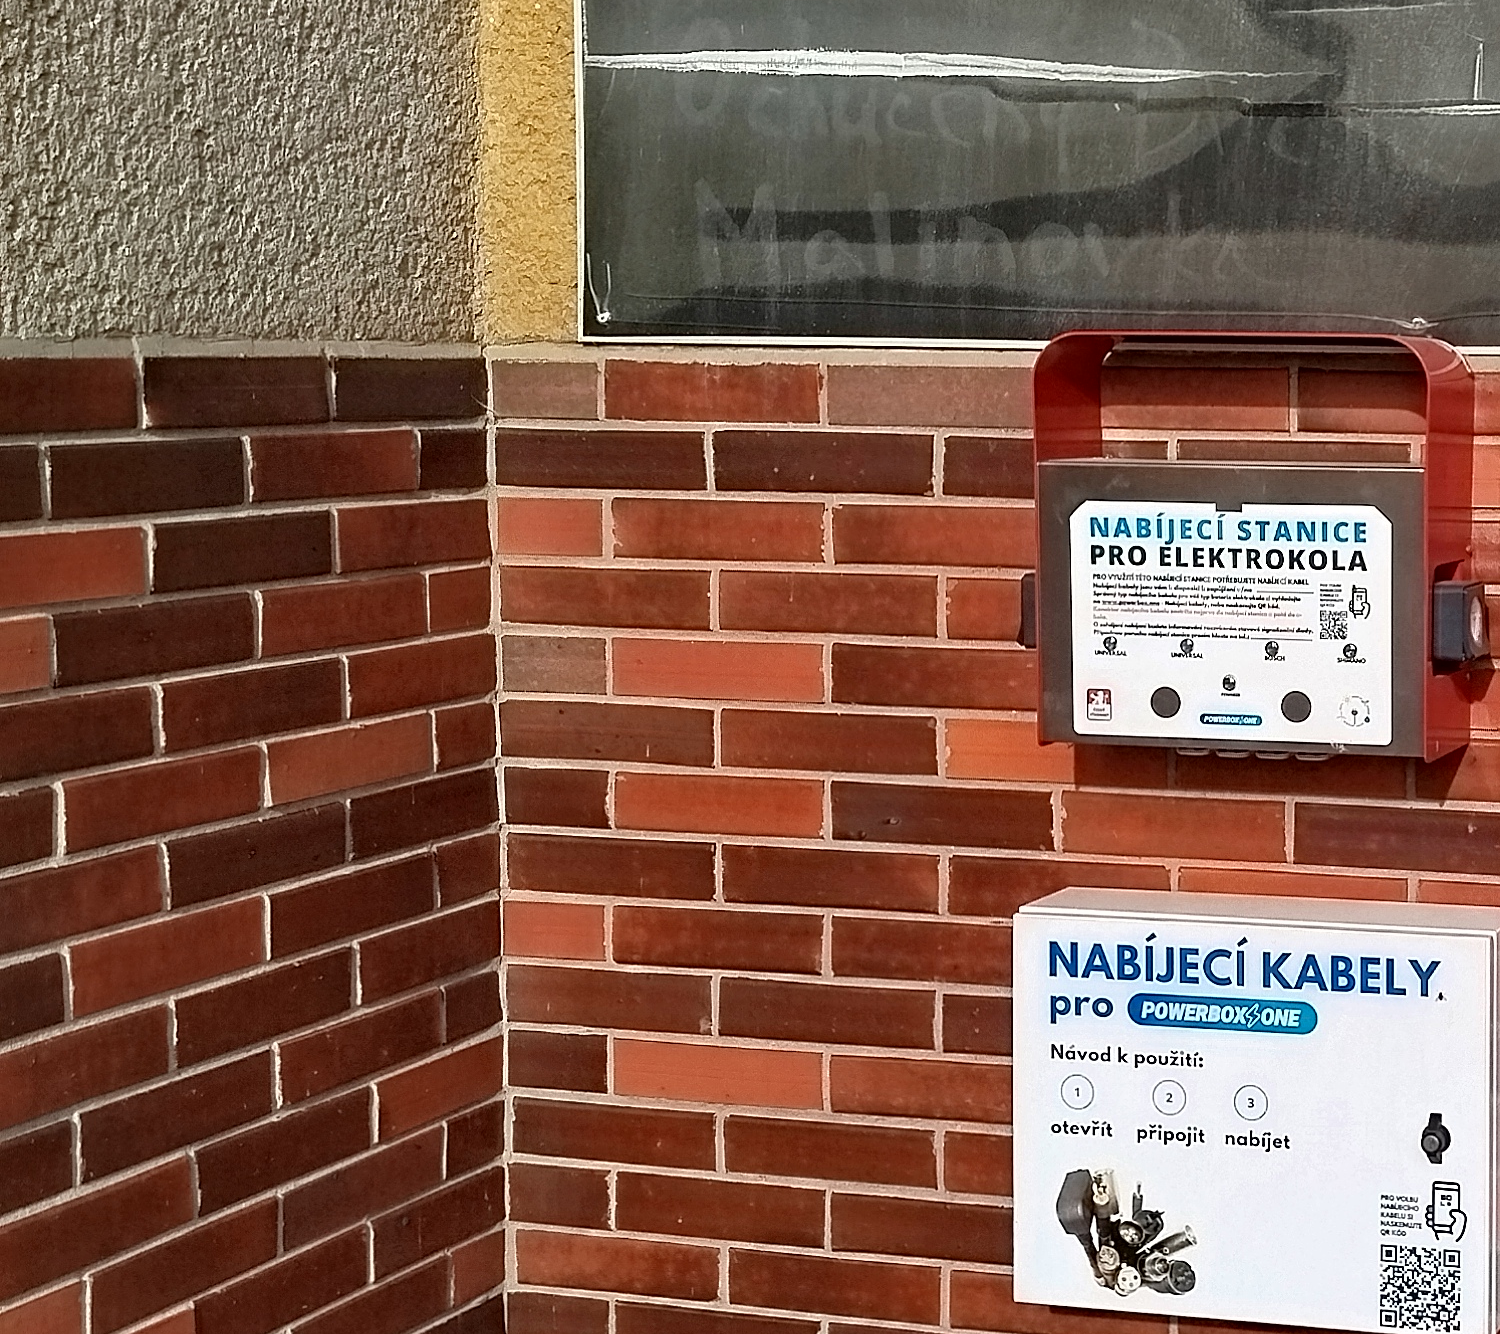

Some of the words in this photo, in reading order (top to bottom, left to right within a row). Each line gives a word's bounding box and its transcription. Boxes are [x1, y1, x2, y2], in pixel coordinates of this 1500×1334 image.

[1089, 512, 1225, 545] NABÍJECÍ
[1237, 520, 1368, 543] STANICE
[1090, 545, 1147, 567] PRO
[1158, 546, 1368, 572] ELEKTROKOLA
[1048, 932, 1249, 987] NABÍJECÍ
[1050, 994, 1114, 1025] pro
[1140, 1000, 1248, 1025] POWERBOX
[1259, 1007, 1302, 1027] ONE
[1050, 1043, 1111, 1063] Návod
[1117, 1046, 1128, 1064] k
[1134, 1049, 1204, 1069] použití:
[1073, 1087, 1081, 1098] 1
[1165, 1092, 1174, 1103] 2
[1246, 1097, 1255, 1109] 3
[1050, 1120, 1113, 1138] otevřít
[1136, 1123, 1206, 1147] připojit
[1224, 1130, 1291, 1153] nabíjet
